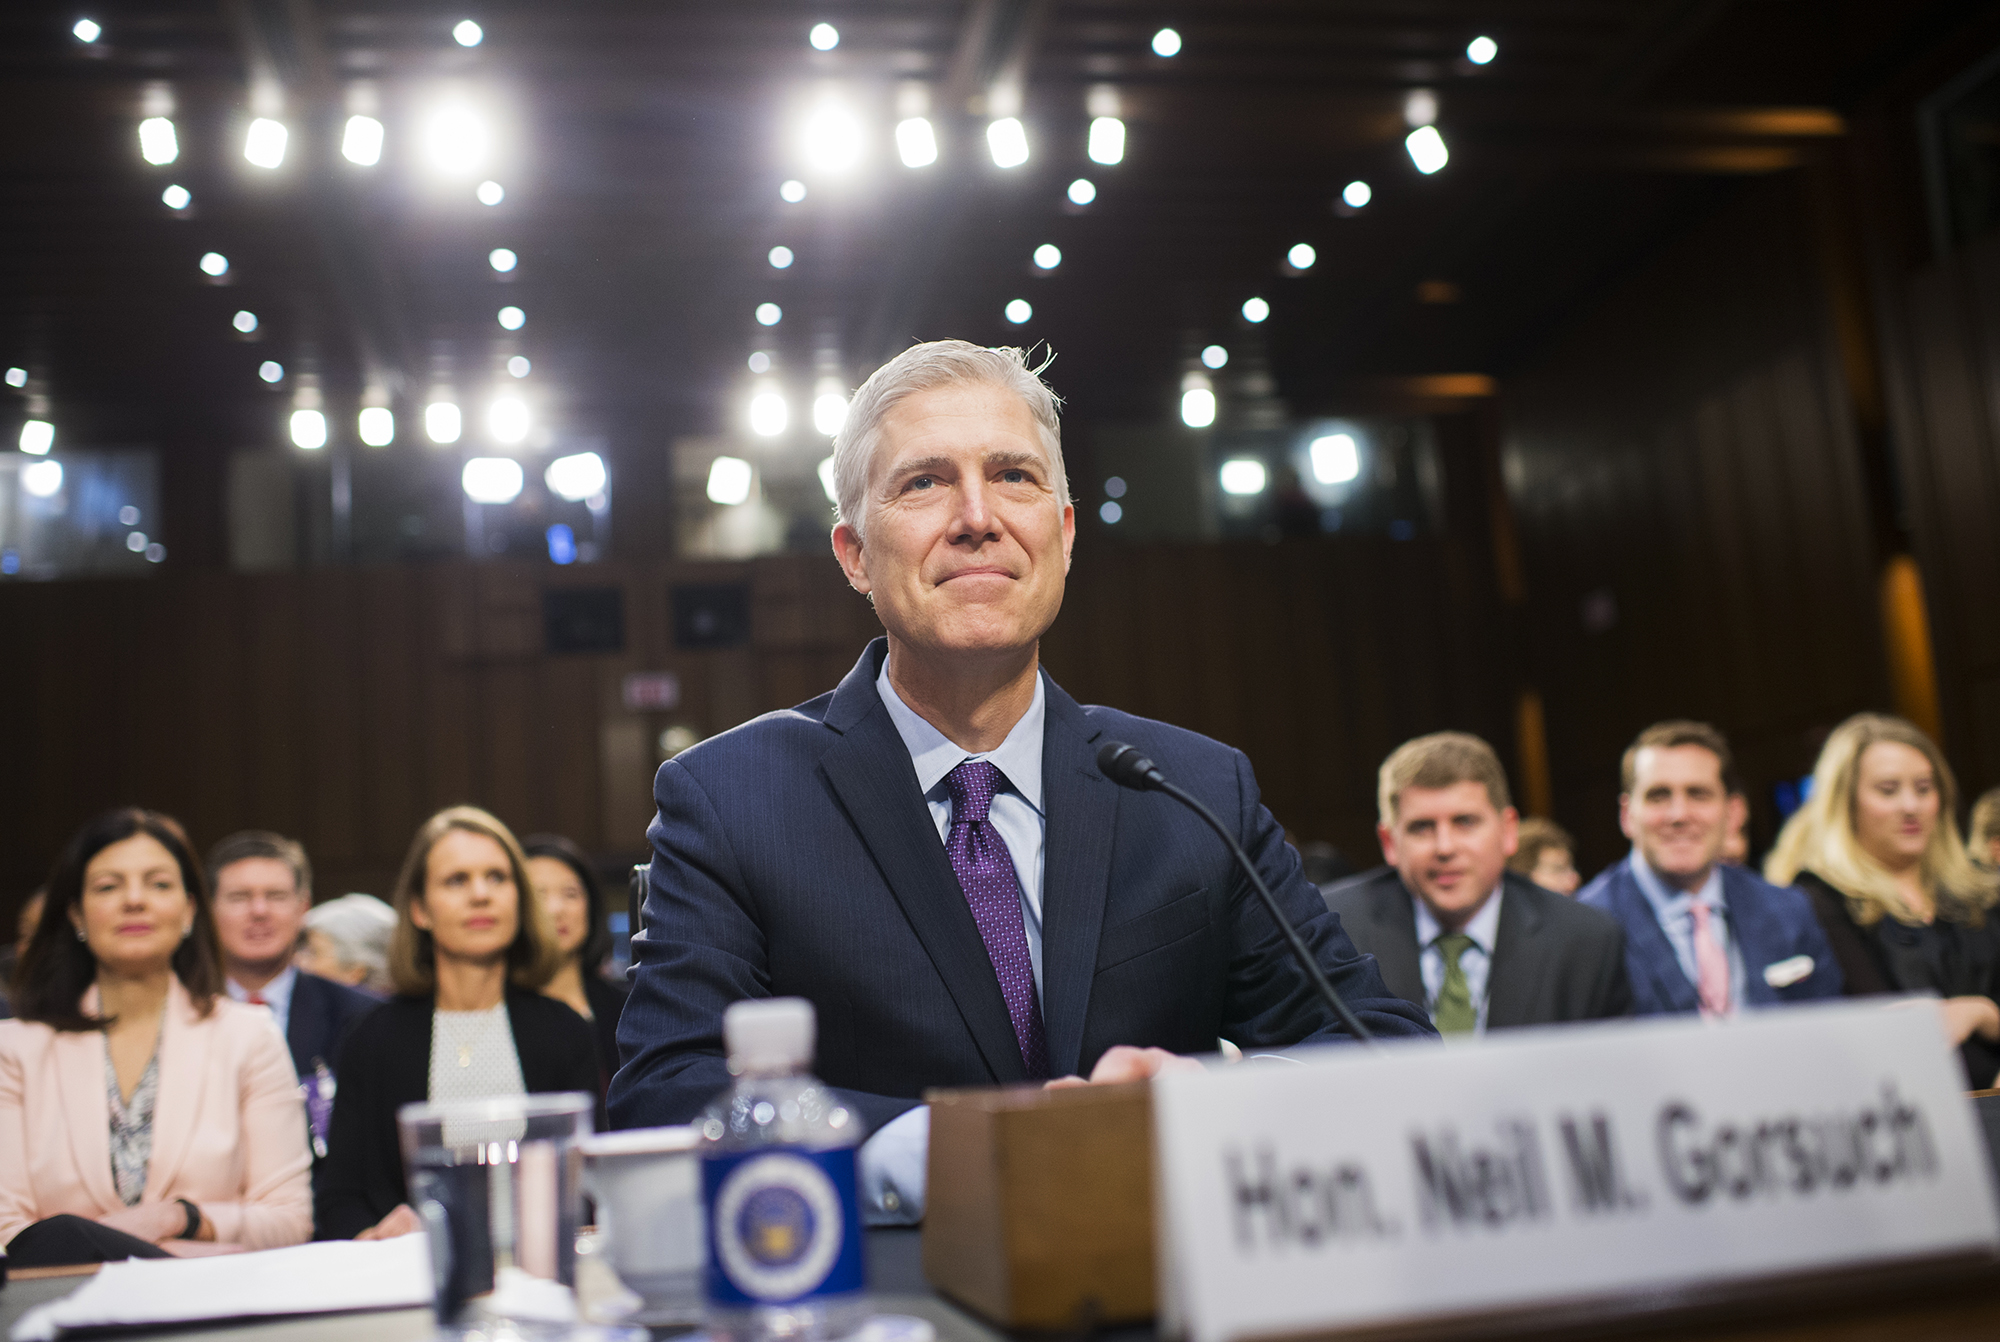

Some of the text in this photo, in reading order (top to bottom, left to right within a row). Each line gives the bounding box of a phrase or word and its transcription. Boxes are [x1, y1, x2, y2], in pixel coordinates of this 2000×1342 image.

[1224, 1078, 1941, 1252] Hon. Neil M. Gorsuch
